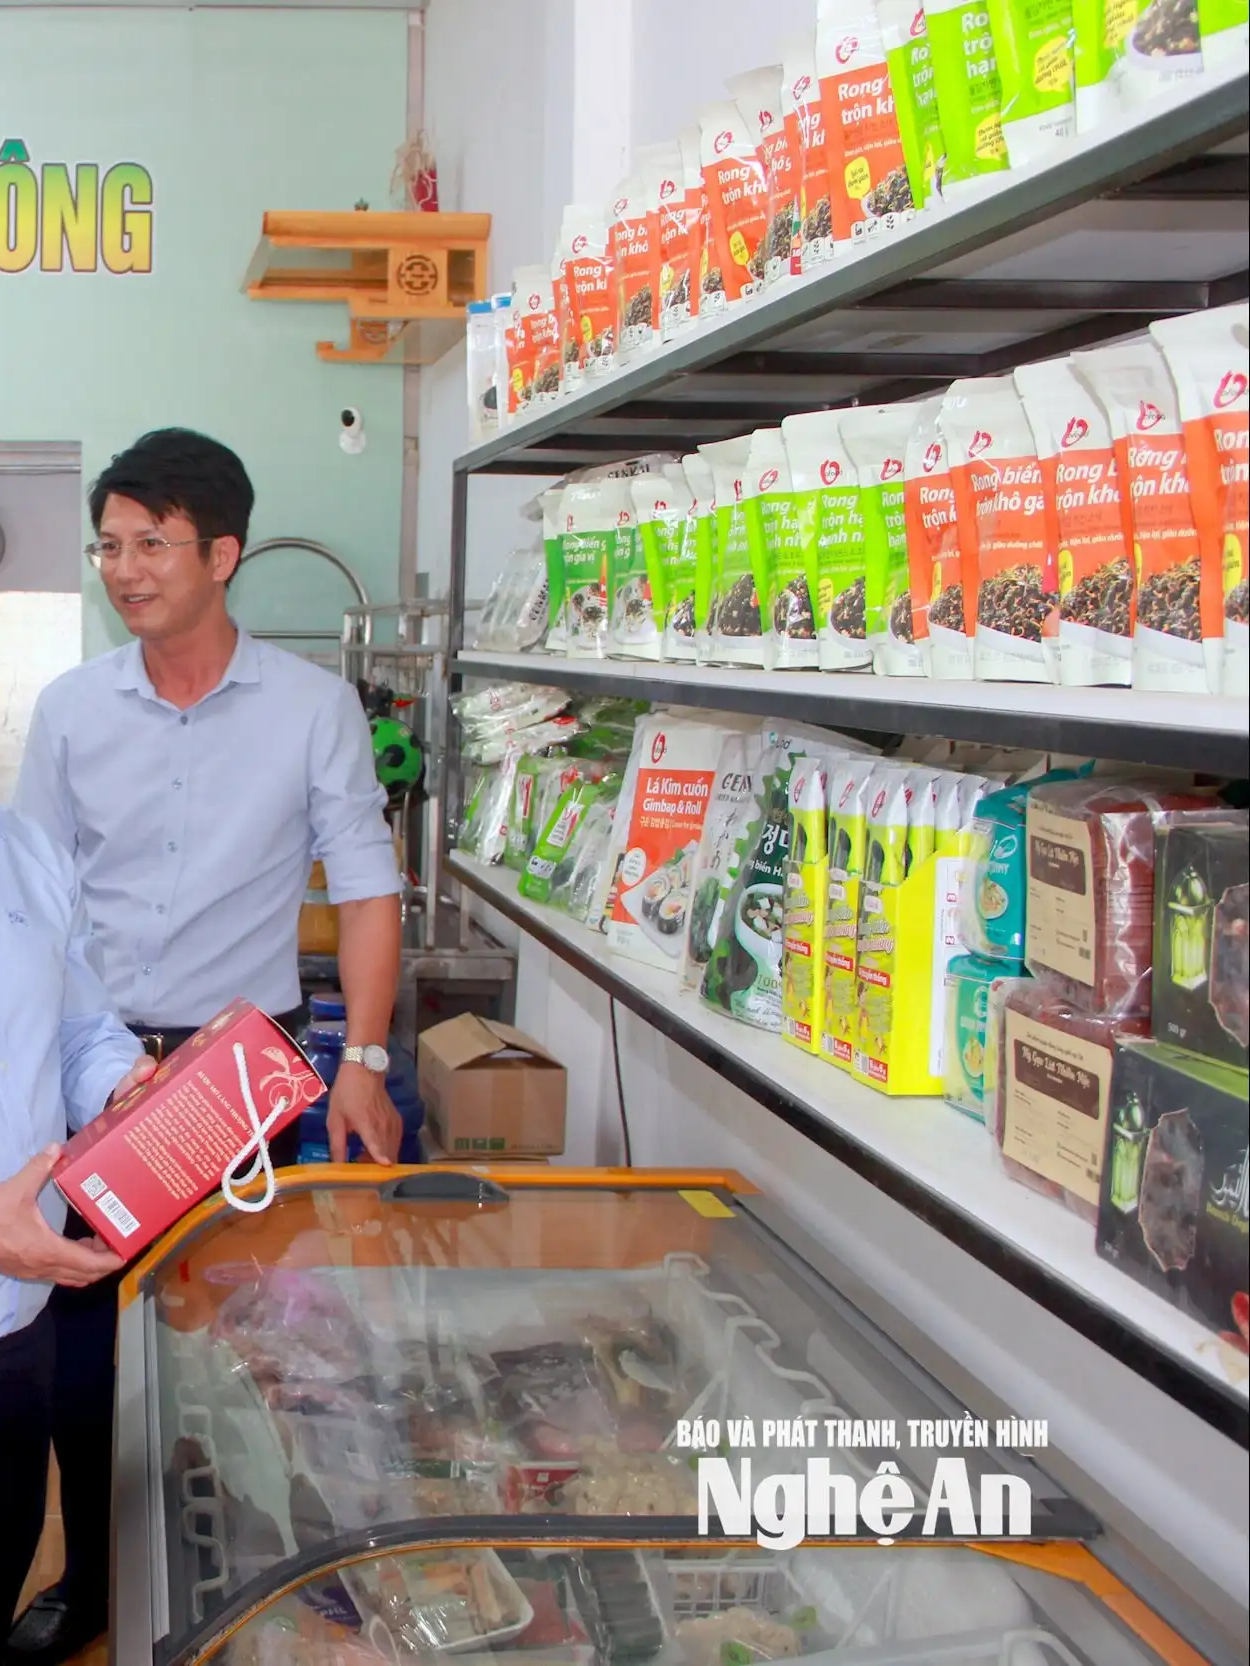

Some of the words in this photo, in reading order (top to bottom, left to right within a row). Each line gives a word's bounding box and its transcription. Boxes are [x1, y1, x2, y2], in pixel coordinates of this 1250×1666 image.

[837, 76, 884, 102] Rong
[841, 103, 873, 127] trộn
[1056, 462, 1104, 483] Rong
[646, 777, 659, 794] Lá
[661, 777, 681, 796] Kim
[682, 777, 708, 797] cuốn
[642, 797, 677, 816] Gimbap
[676, 799, 685, 814] &
[685, 800, 702, 815] Roll
